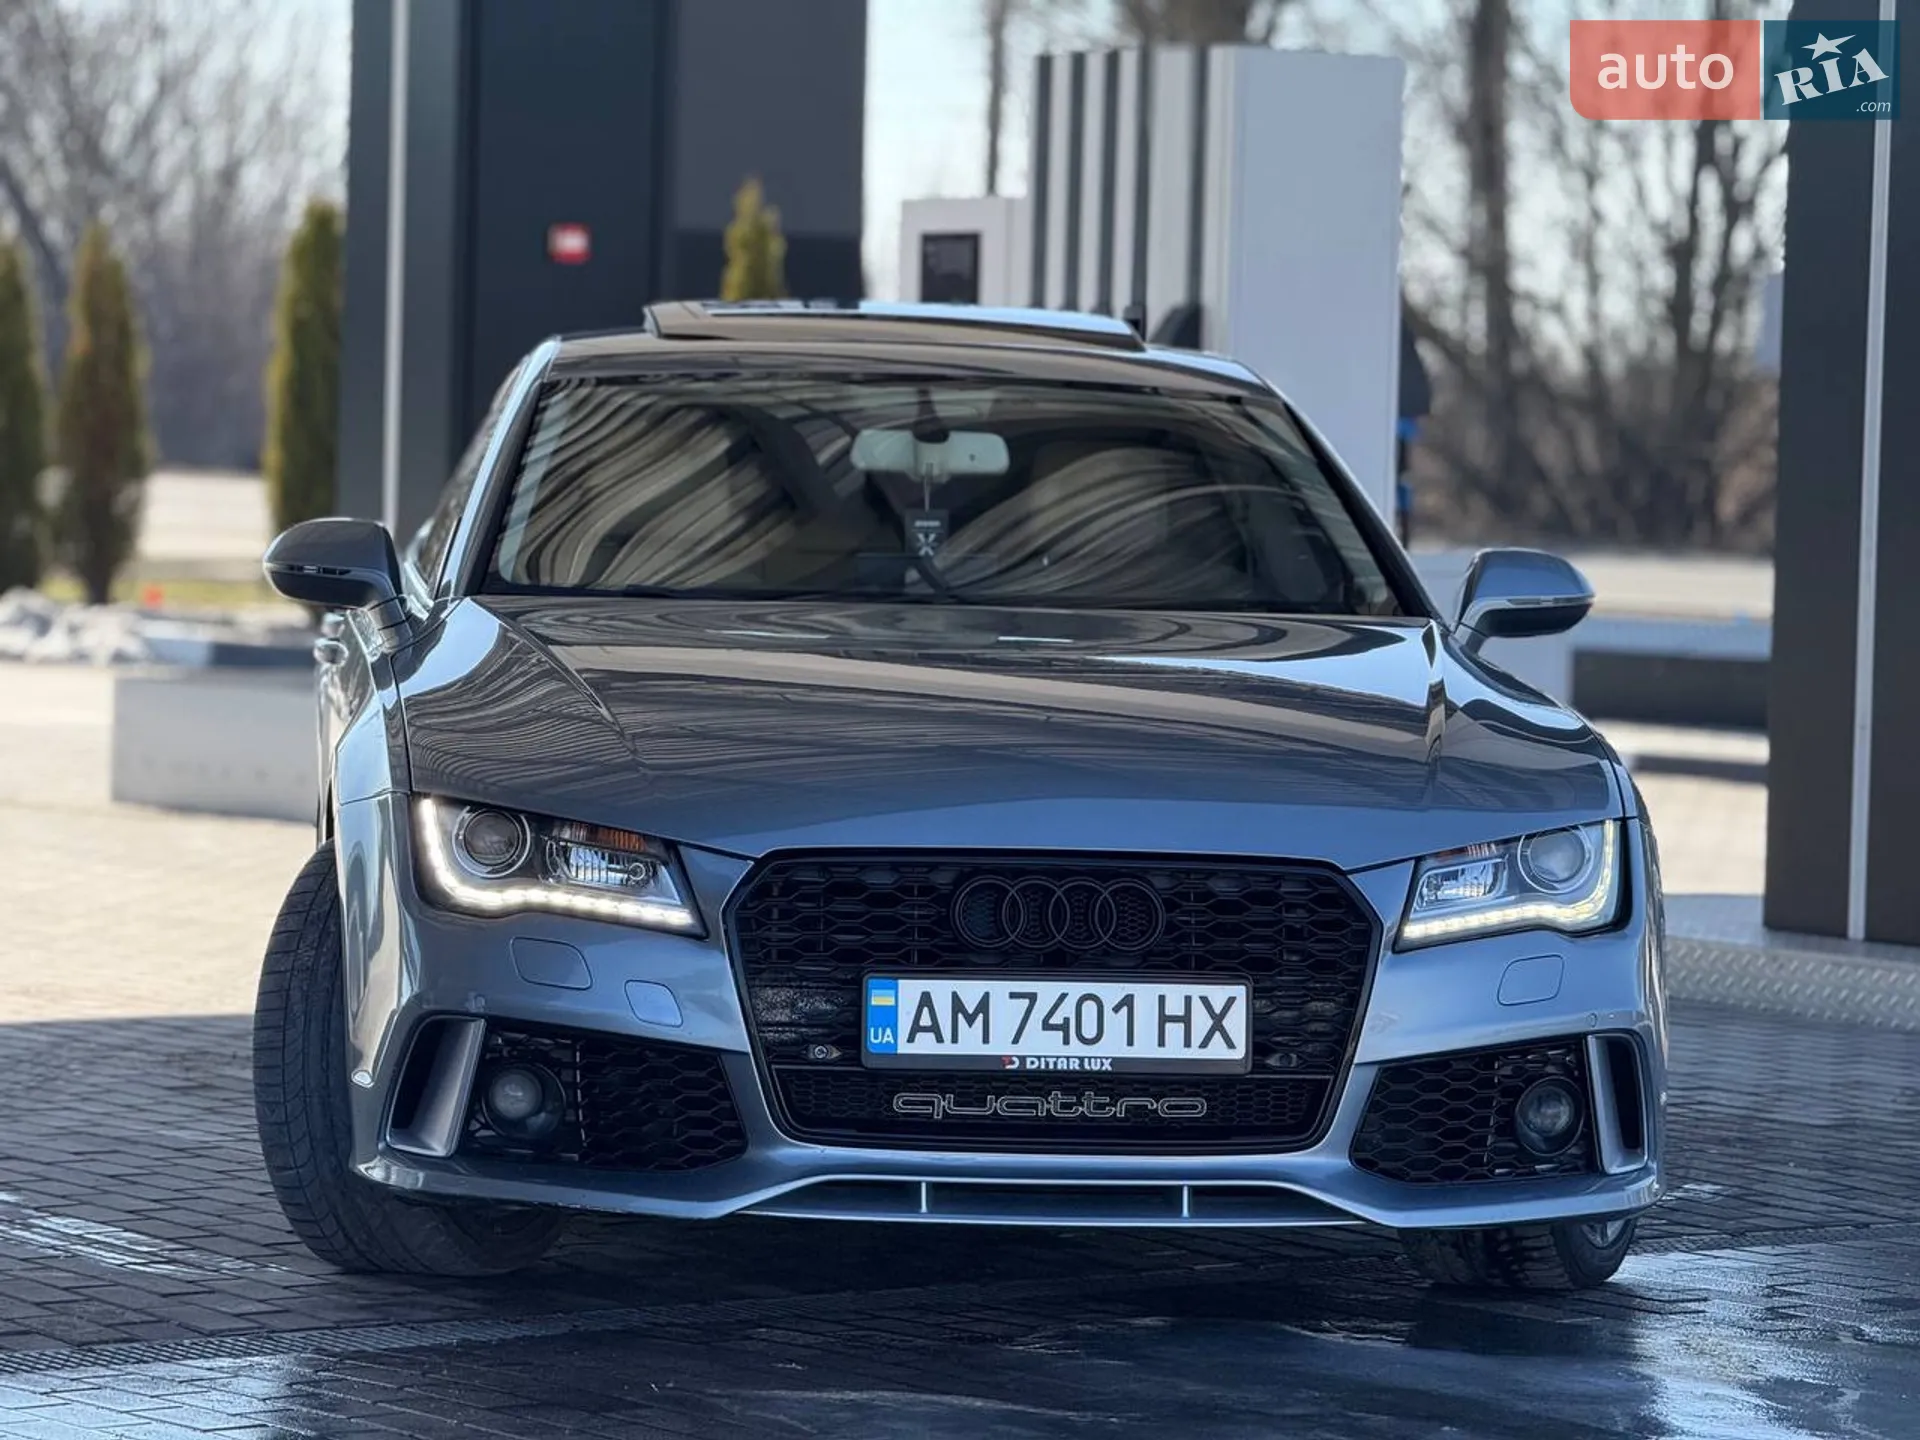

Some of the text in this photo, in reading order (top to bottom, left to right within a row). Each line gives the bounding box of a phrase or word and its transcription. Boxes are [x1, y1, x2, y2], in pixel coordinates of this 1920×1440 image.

[906, 991, 1237, 1050] AM 7401 HX
[870, 1027, 894, 1044] UA
[1026, 1057, 1112, 1071] DITAR LUX
[893, 1092, 1207, 1119] quattro
